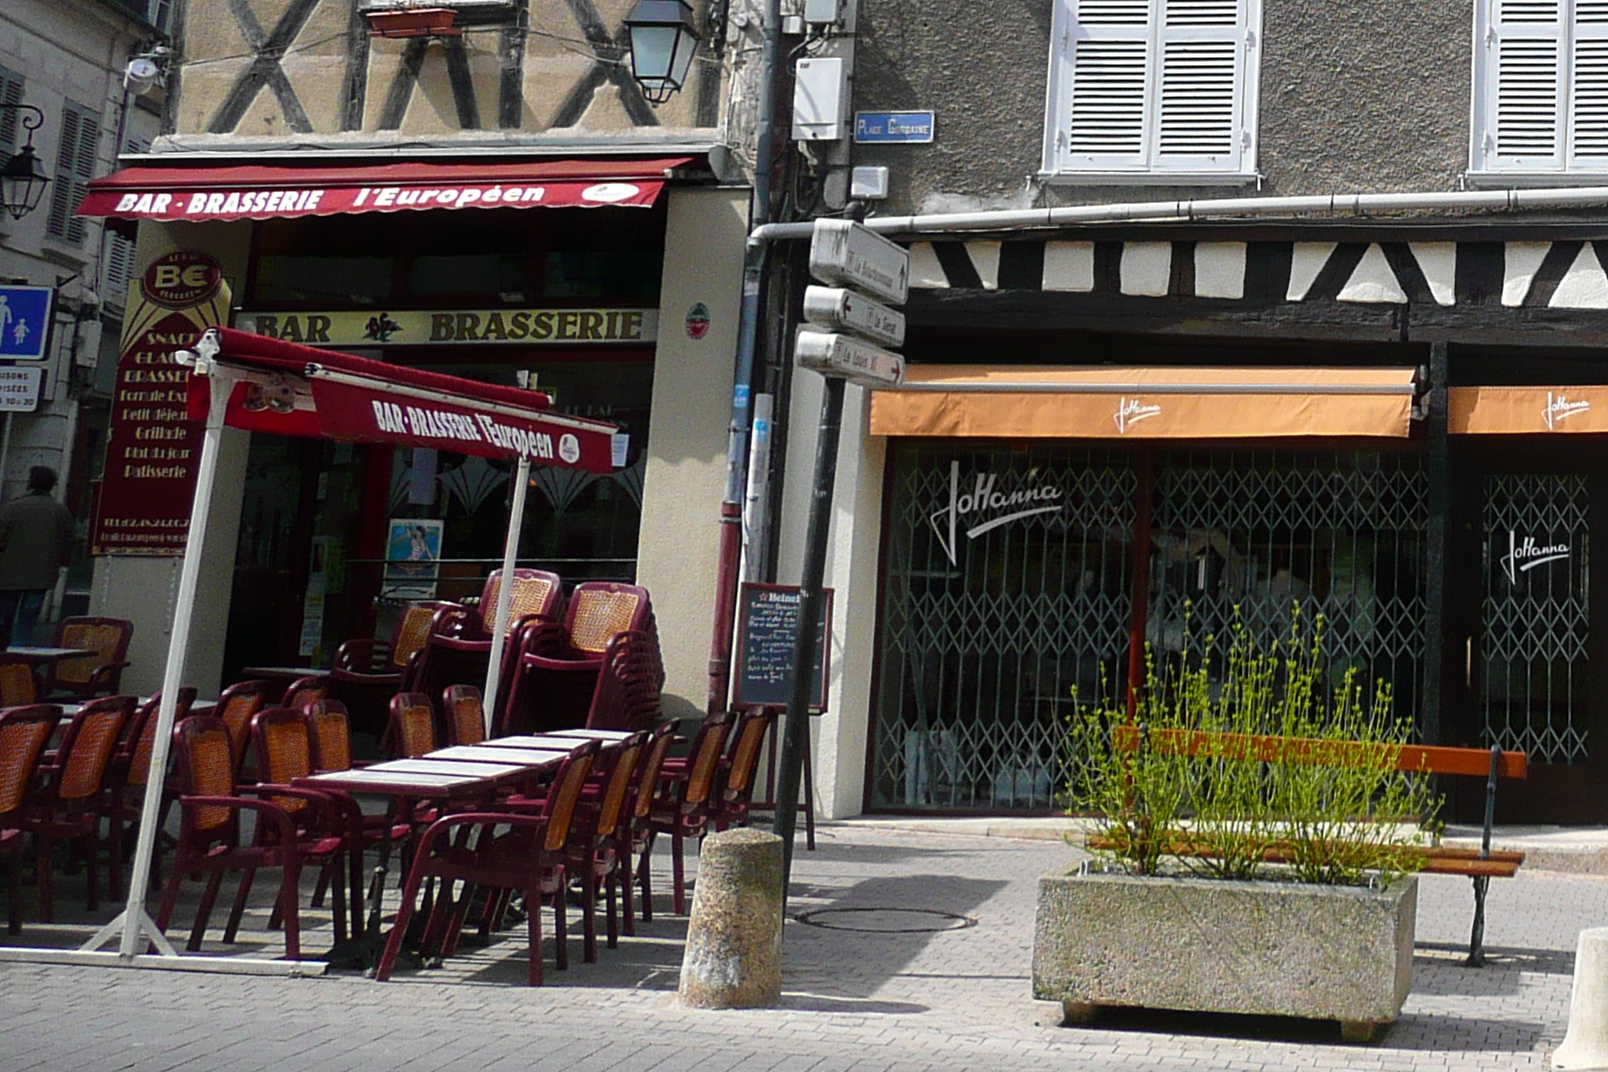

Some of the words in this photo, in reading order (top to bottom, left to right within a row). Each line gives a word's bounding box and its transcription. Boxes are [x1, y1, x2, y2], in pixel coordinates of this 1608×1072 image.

[115, 193, 172, 213] BAR
[186, 190, 325, 214] BRASSERIE
[353, 184, 546, 208] l'Européen
[256, 315, 332, 344] BAR
[429, 311, 643, 342] BRASSERIE
[124, 370, 191, 383] BRASSE
[372, 400, 407, 434] BAR
[406, 406, 482, 441] BRASSERIE
[475, 413, 554, 461] l'Européen
[769, 592, 800, 603] Heine
